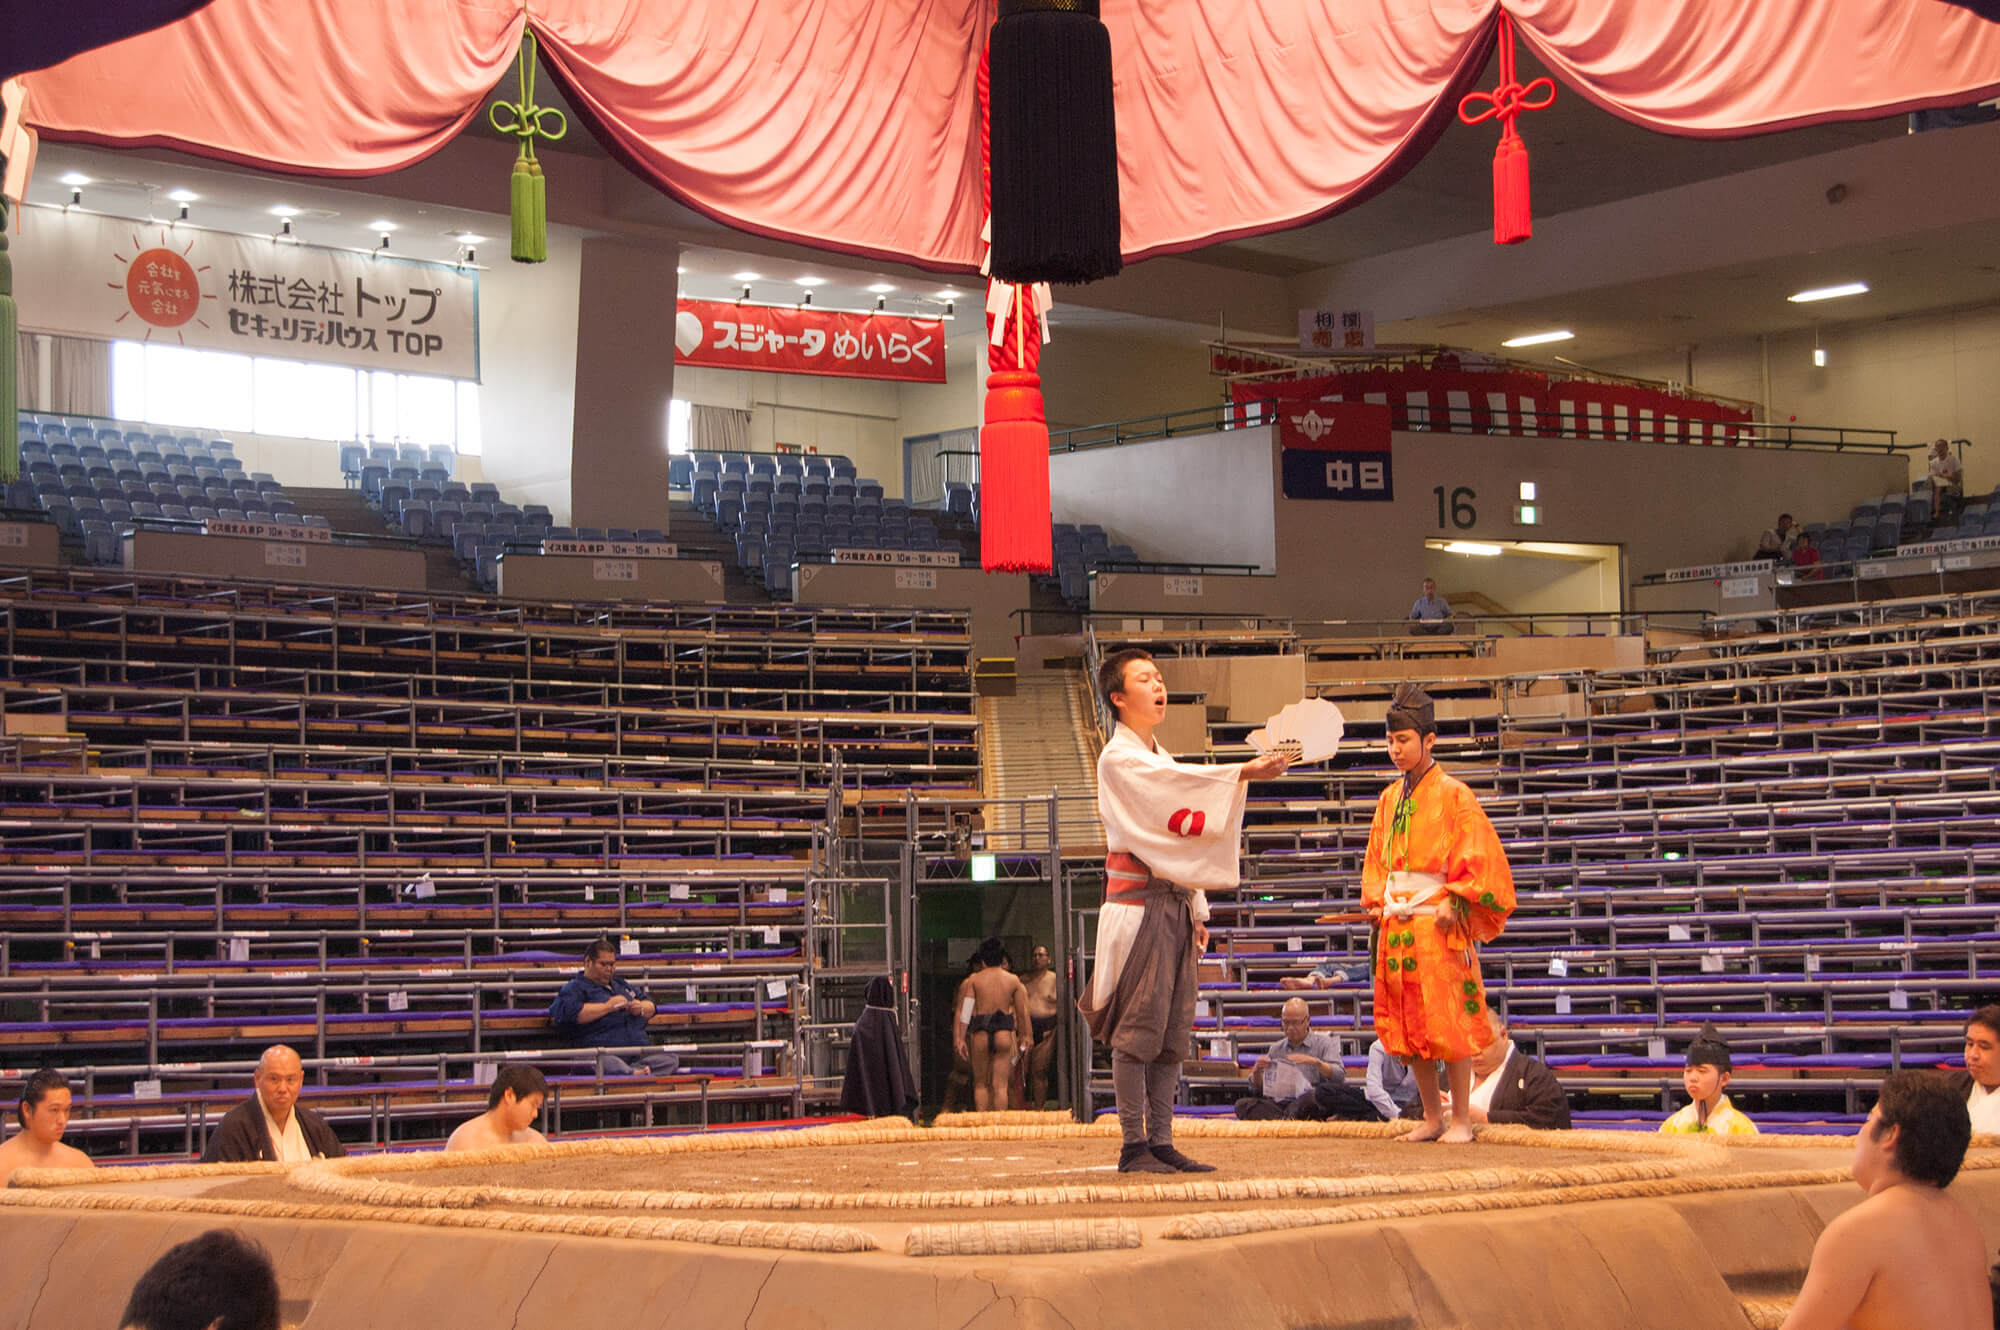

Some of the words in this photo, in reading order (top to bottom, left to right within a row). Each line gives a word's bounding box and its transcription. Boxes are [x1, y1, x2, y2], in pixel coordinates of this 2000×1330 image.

[151, 299, 179, 316] 会社
[228, 268, 345, 316] 株式会社
[357, 277, 442, 325] トップ
[228, 308, 379, 352] セキュリティハウス
[387, 329, 443, 357] TOP
[713, 321, 826, 357] スジャータ
[832, 330, 933, 366] めいらく
[1325, 459, 1385, 491] 中日
[1433, 485, 1477, 530] 16
[711, 565, 720, 577] P
